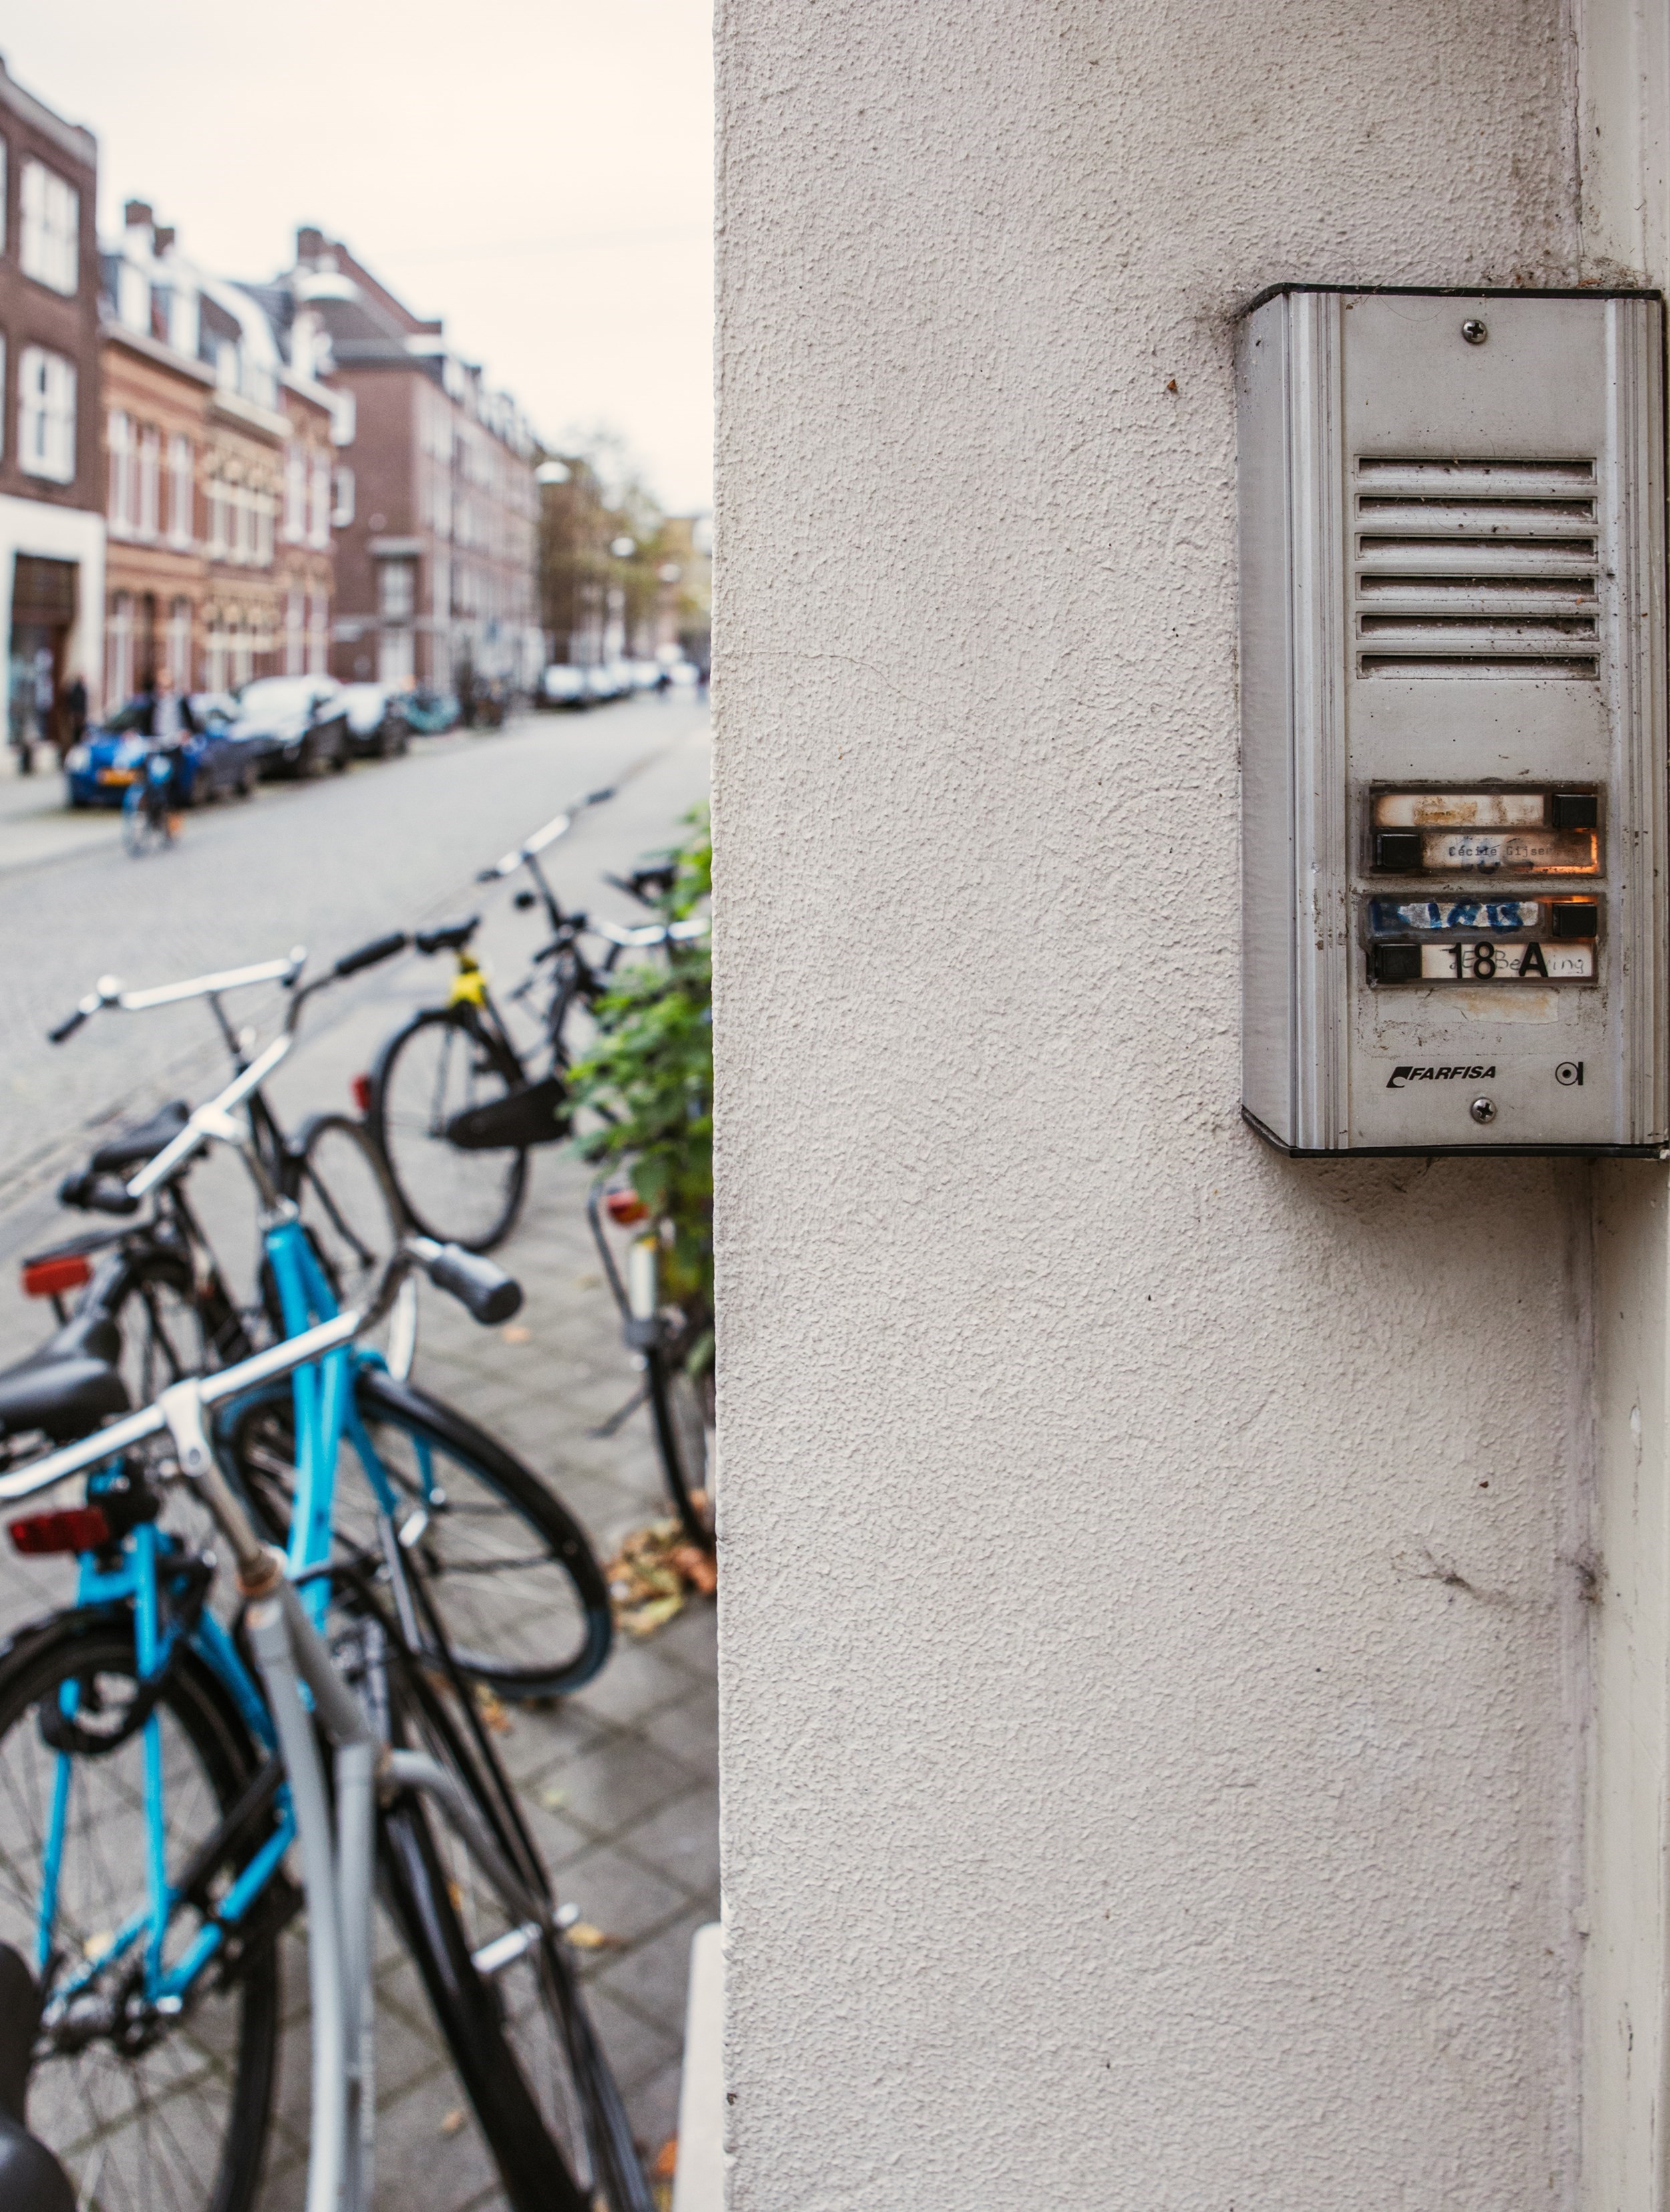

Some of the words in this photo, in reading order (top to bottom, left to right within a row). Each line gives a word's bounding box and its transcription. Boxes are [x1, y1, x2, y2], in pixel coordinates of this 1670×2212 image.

[1448, 941, 1496, 980] 18
[1518, 941, 1548, 977] A
[1408, 1066, 1496, 1080] FARFISA
